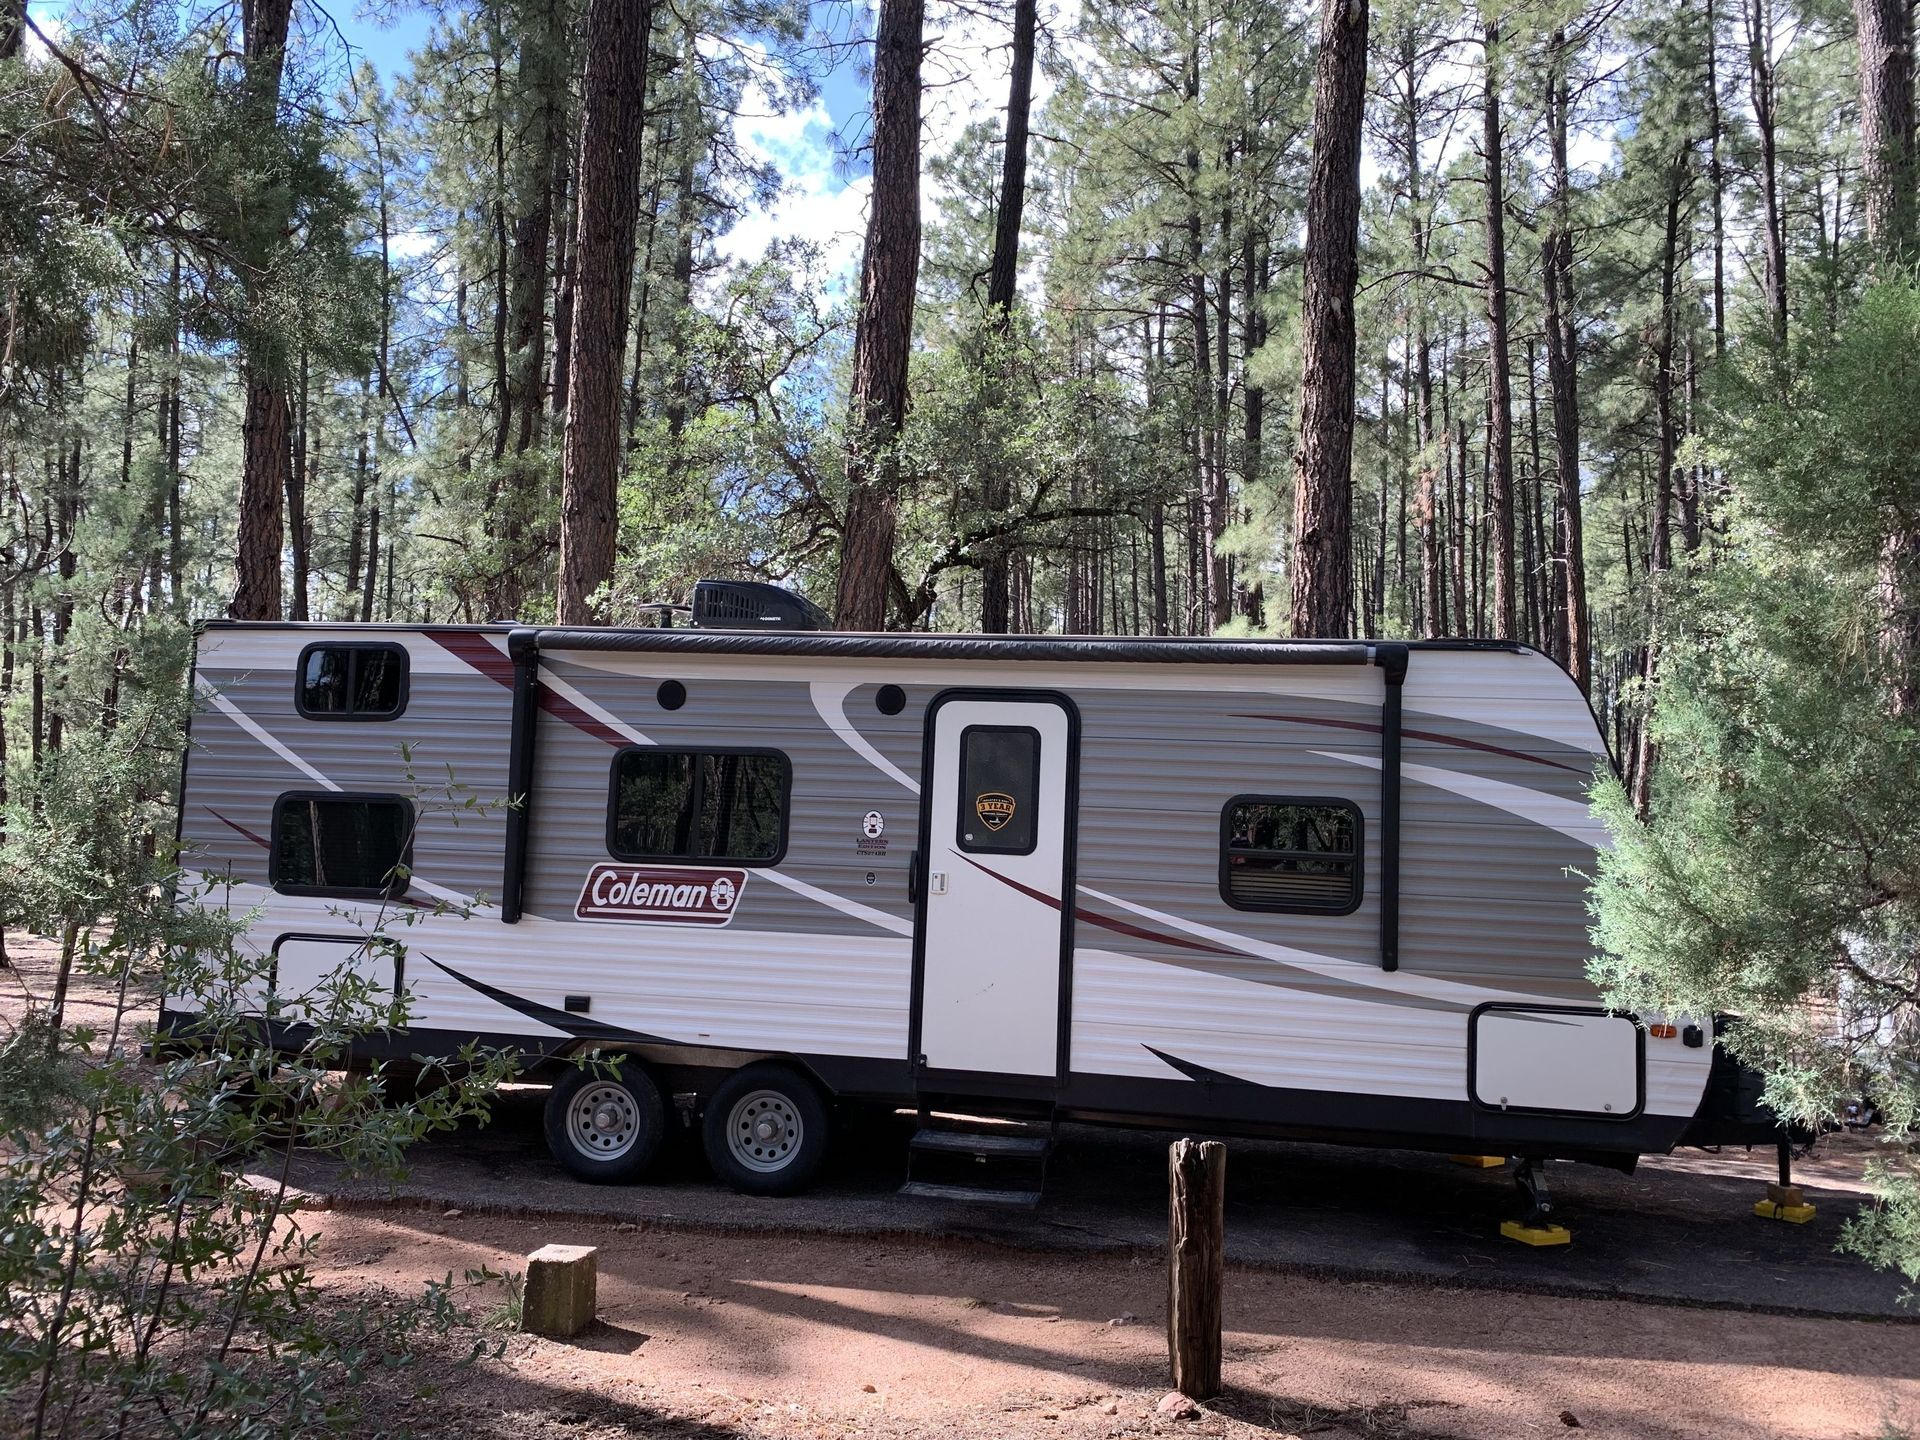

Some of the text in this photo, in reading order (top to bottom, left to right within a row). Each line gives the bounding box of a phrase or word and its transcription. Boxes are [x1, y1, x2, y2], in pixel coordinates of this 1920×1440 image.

[980, 802, 1011, 811] 3 YEAR
[591, 870, 708, 909] Coleman
